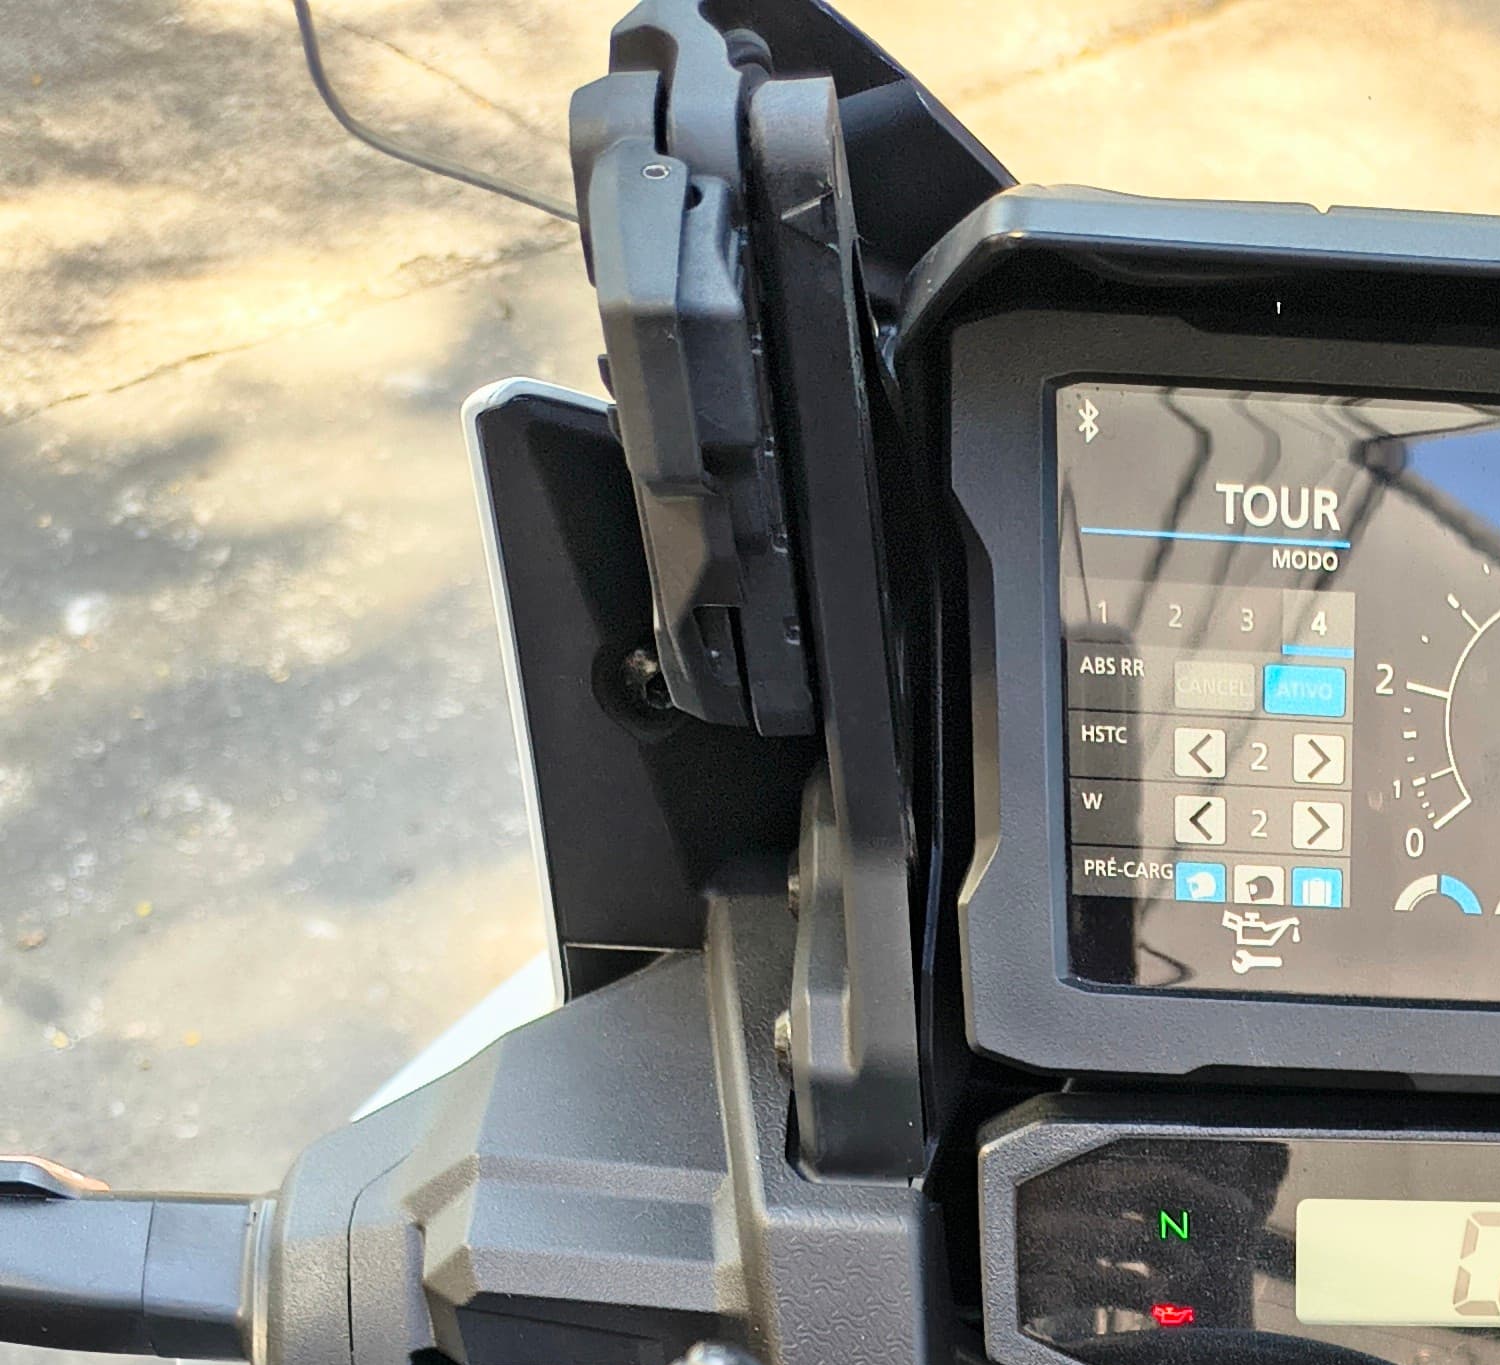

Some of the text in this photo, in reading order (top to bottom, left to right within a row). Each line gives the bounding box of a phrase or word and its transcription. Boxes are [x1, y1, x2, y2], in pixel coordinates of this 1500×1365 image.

[1215, 482, 1341, 531] TOUR
[1272, 550, 1339, 573] MODO
[1098, 600, 1327, 636] 1 2 3 4
[1080, 656, 1145, 678] ABS RR
[1375, 664, 1394, 696] 2
[1276, 682, 1334, 701] ATIVO
[1081, 725, 1269, 772] HSTC 2
[1391, 780, 1401, 799] 1
[1082, 793, 1268, 839] W 2
[1404, 827, 1425, 858] 0
[1083, 855, 1174, 880] PRÉ-CARG
[1159, 1209, 1191, 1240] N
